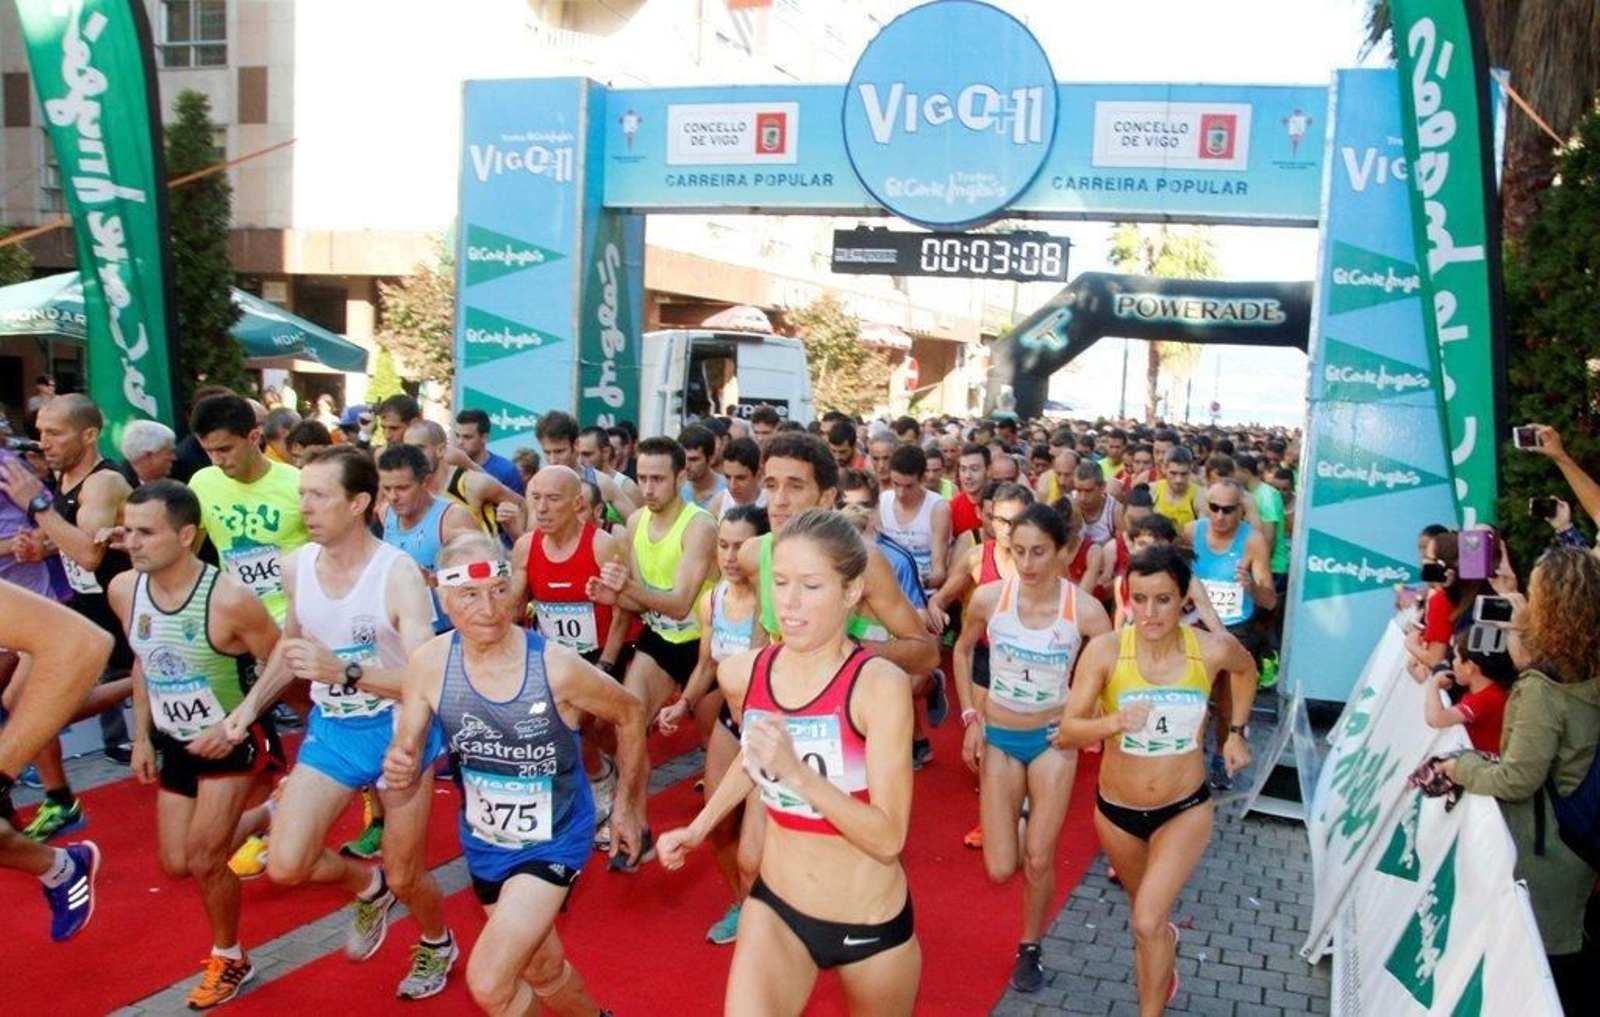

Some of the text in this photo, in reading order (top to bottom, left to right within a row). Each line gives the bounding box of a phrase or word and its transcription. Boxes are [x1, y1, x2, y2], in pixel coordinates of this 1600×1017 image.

[683, 121, 748, 134] CONCELLO
[1113, 120, 1190, 135] CONCELLO
[690, 134, 740, 147] DE VIGO
[1121, 135, 1180, 149] DE VIGO
[665, 172, 835, 188] CARREIRA POPULAR
[1052, 175, 1249, 196] CARREIRA POPULAR
[921, 237, 1063, 277] 00:03:08
[1116, 294, 1277, 322] POWERADE
[238, 557, 281, 585] 846
[554, 618, 582, 639] 10
[163, 697, 212, 723] 404
[1155, 715, 1168, 734] 4
[460, 739, 556, 761] castrelos
[479, 798, 539, 833] 375
